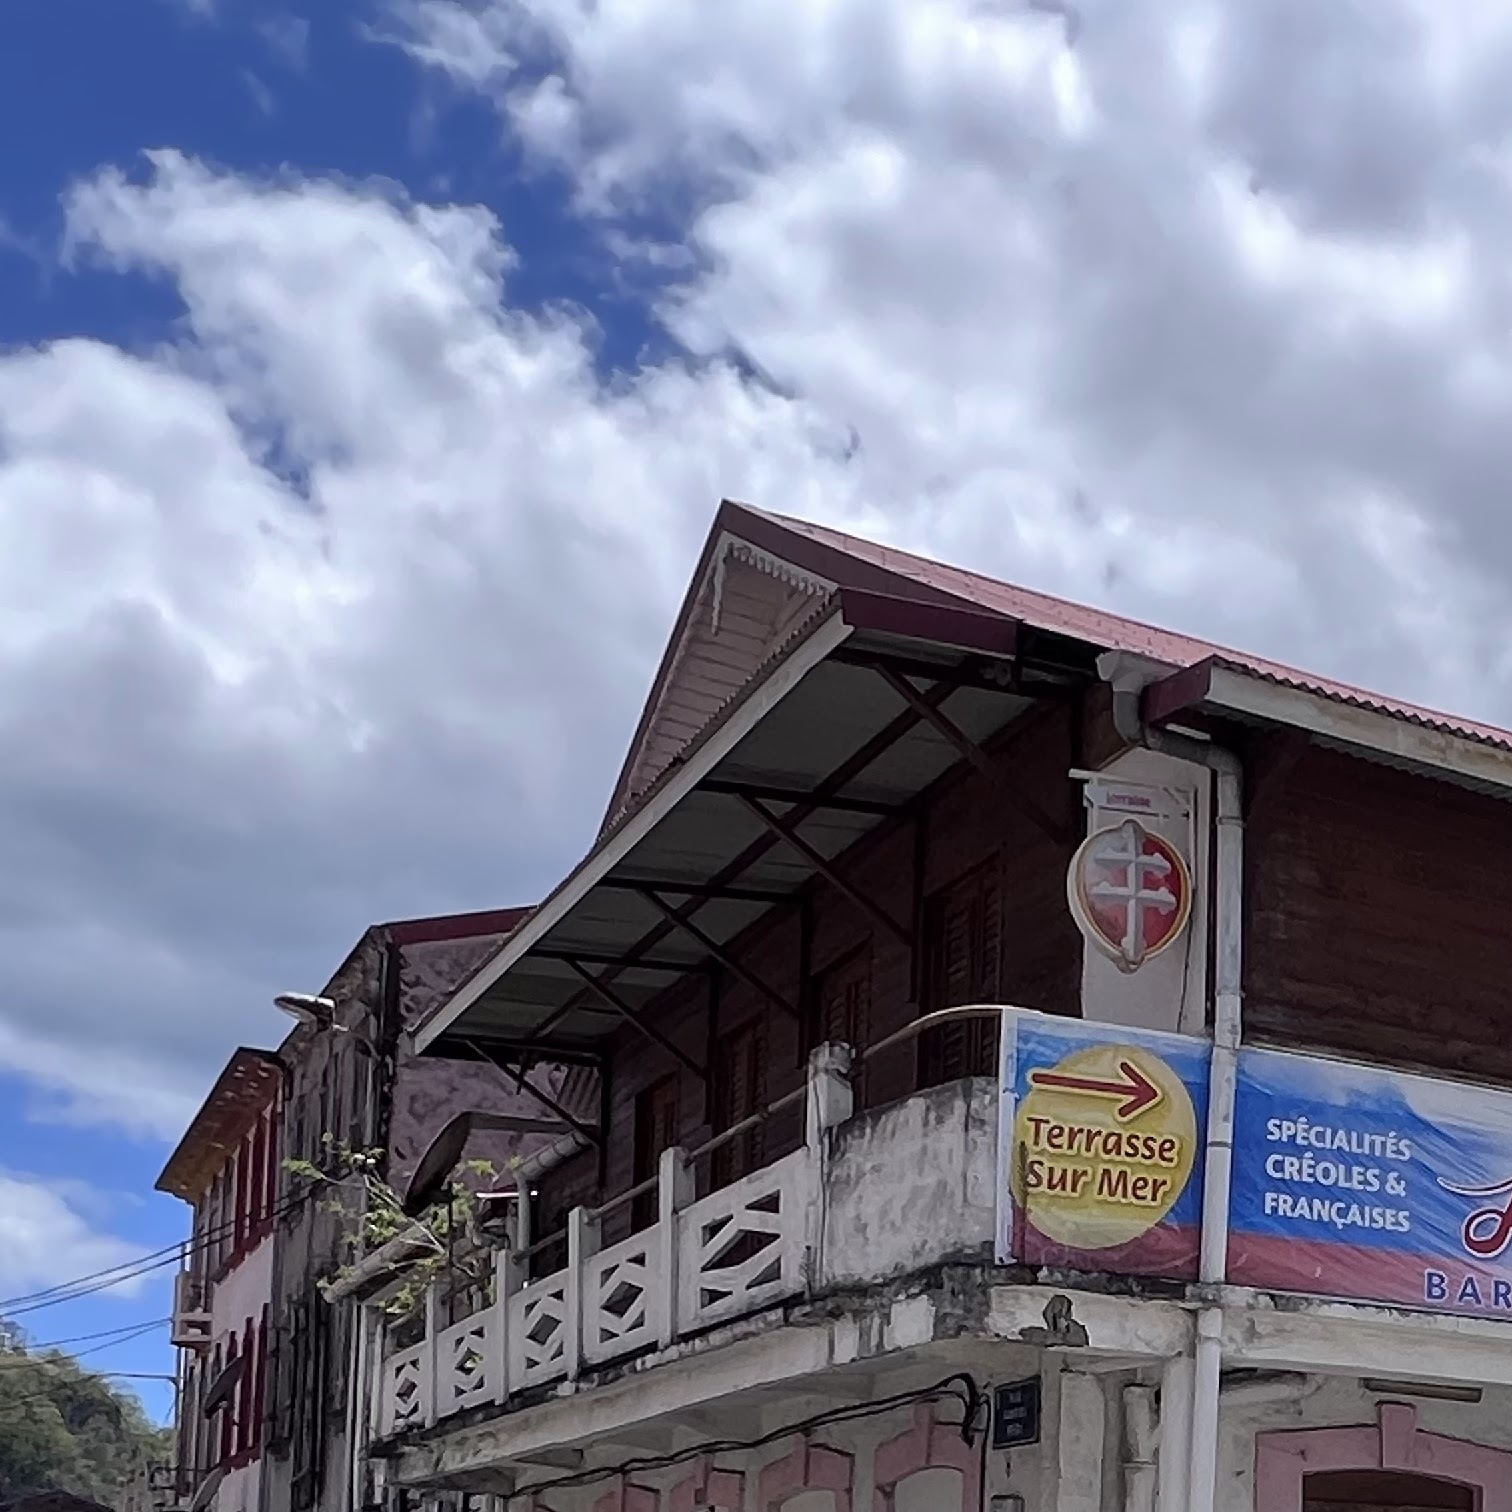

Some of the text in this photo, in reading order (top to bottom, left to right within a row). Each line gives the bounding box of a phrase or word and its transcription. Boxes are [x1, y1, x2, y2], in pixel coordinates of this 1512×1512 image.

[1027, 1116, 1176, 1163] Terrasse
[1266, 1116, 1412, 1162] SPÉCIALITÉS
[1097, 1168, 1168, 1202] Mer
[1266, 1151, 1407, 1198] CRÉOLES &
[1264, 1192, 1411, 1232] FRANÇAISES
